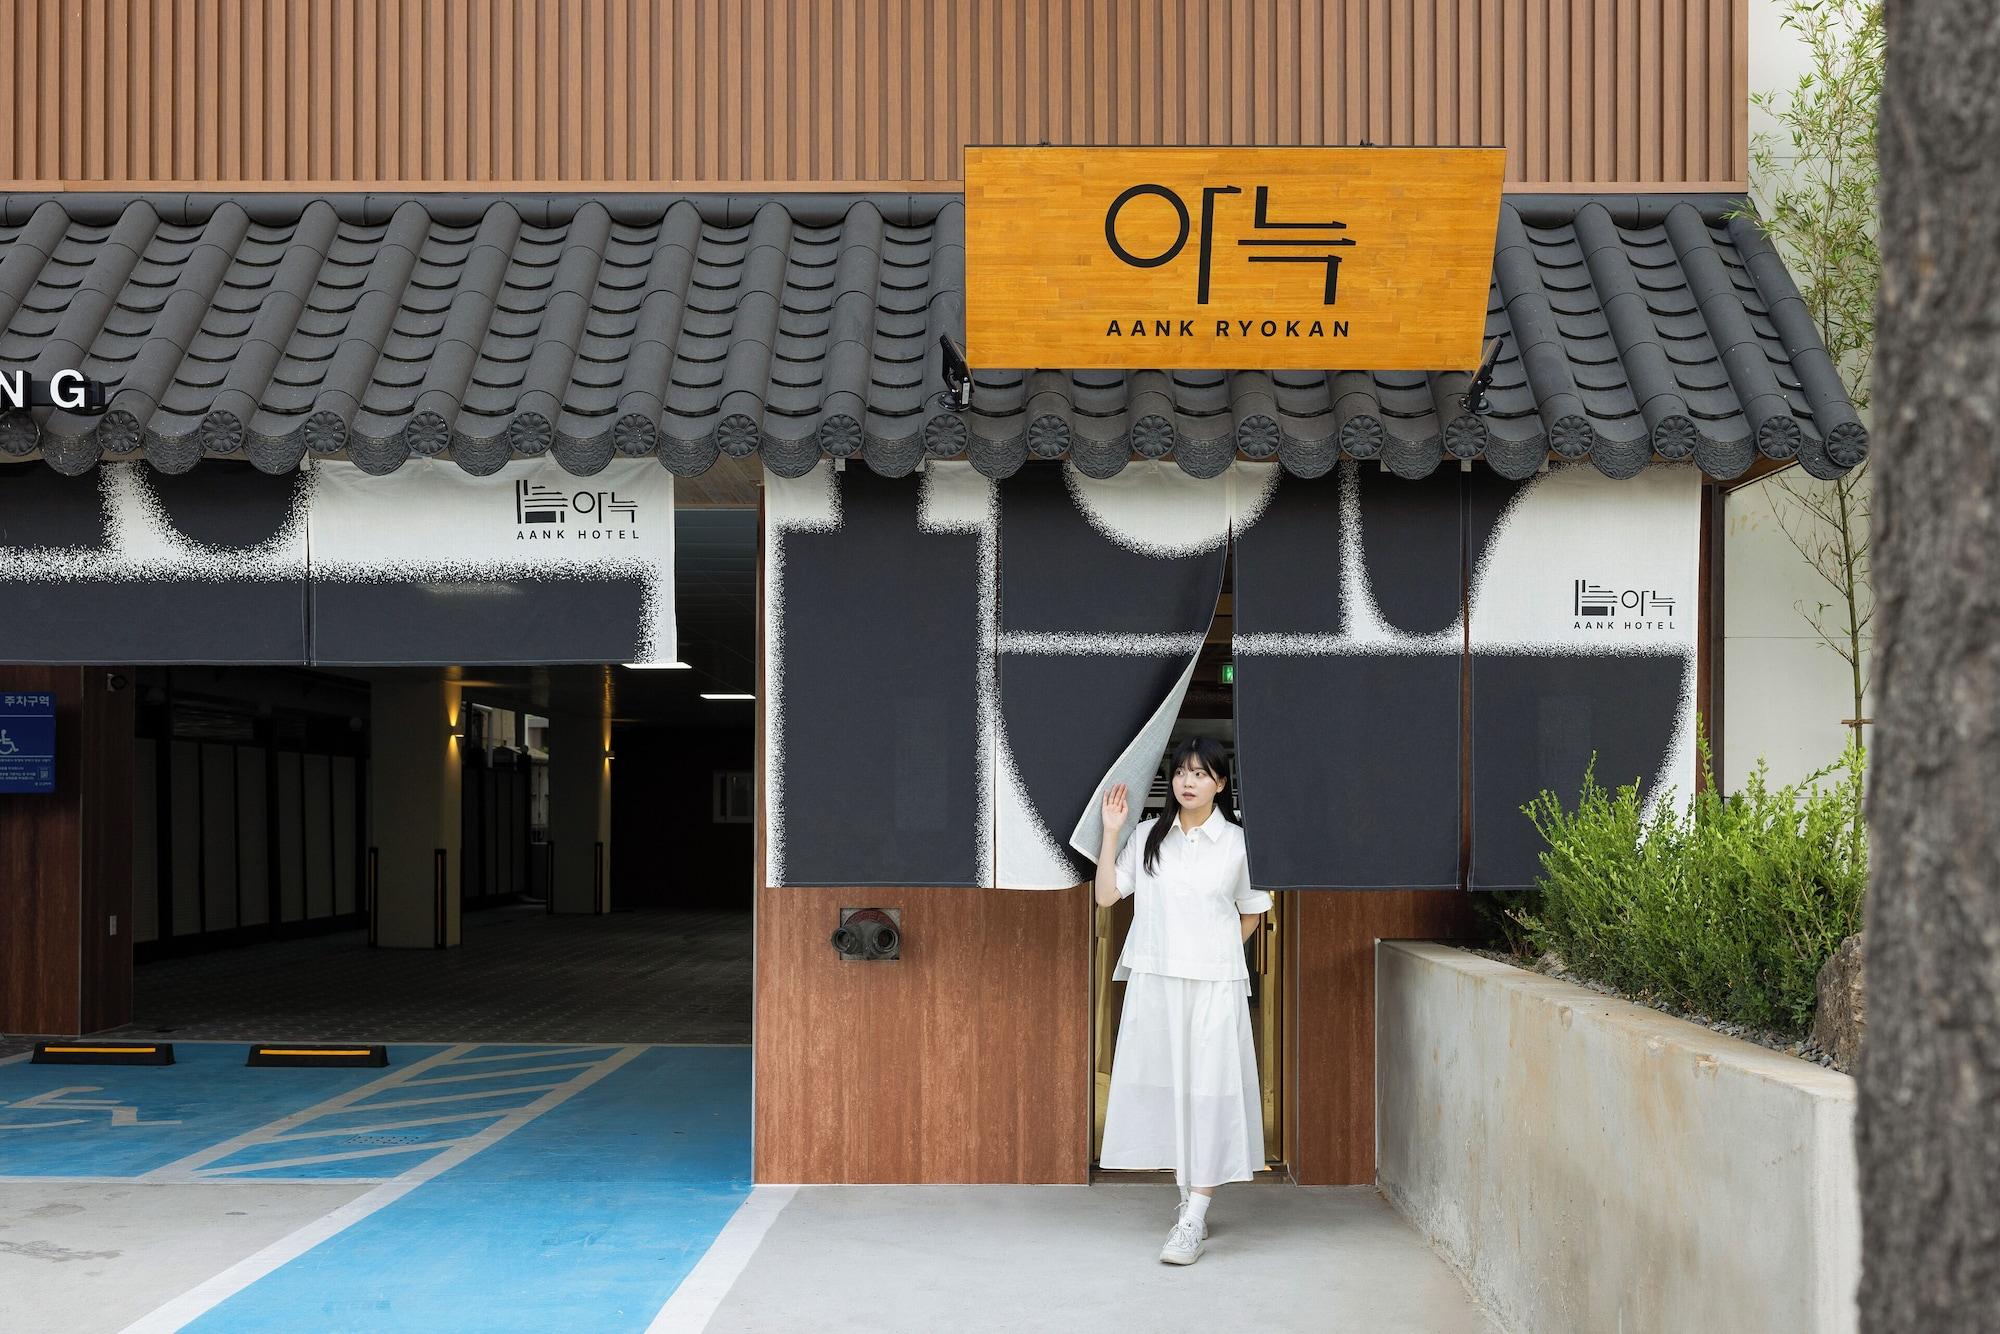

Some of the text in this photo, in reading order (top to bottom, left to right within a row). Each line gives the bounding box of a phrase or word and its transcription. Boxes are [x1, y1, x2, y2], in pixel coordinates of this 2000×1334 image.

[1105, 183, 1356, 305] 아늑
[1106, 320, 1349, 337] AANK RYOKAN
[516, 530, 639, 540] AANK HOTEL
[1573, 621, 1675, 630] AANK HOTEL
[4, 695, 50, 707] 주차구역
